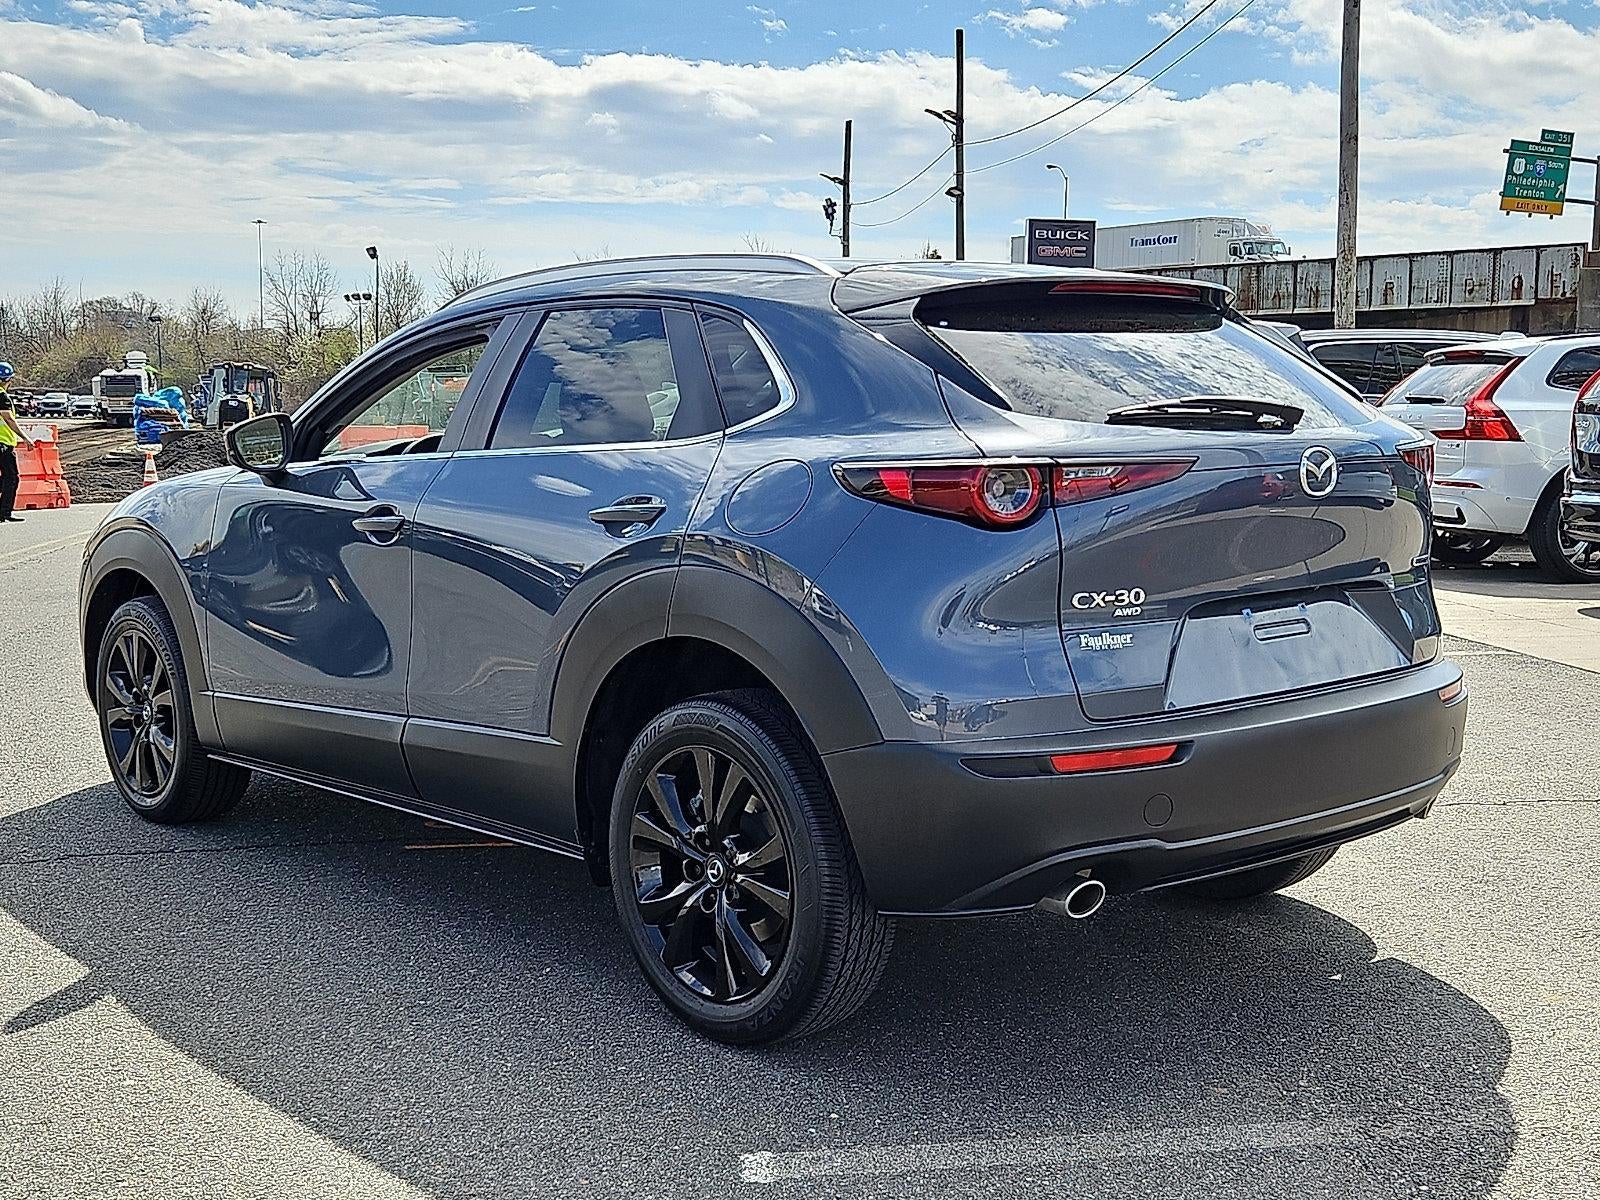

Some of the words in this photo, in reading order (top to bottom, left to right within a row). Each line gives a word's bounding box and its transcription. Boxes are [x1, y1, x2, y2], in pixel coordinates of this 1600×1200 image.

[1558, 133, 1572, 143] 351
[1536, 164, 1545, 174] 95
[1506, 174, 1555, 188] Philadelphia
[1515, 187, 1545, 198] Trenton
[1516, 202, 1530, 210] EXIT
[1532, 203, 1548, 211] ONLY
[1035, 229, 1090, 241] BUICK
[1130, 235, 1178, 248] TransCorr
[1037, 245, 1087, 258] GMC
[1071, 588, 1146, 608] CX-30
[1113, 607, 1142, 617] AWD
[1079, 632, 1133, 648] Faulkner
